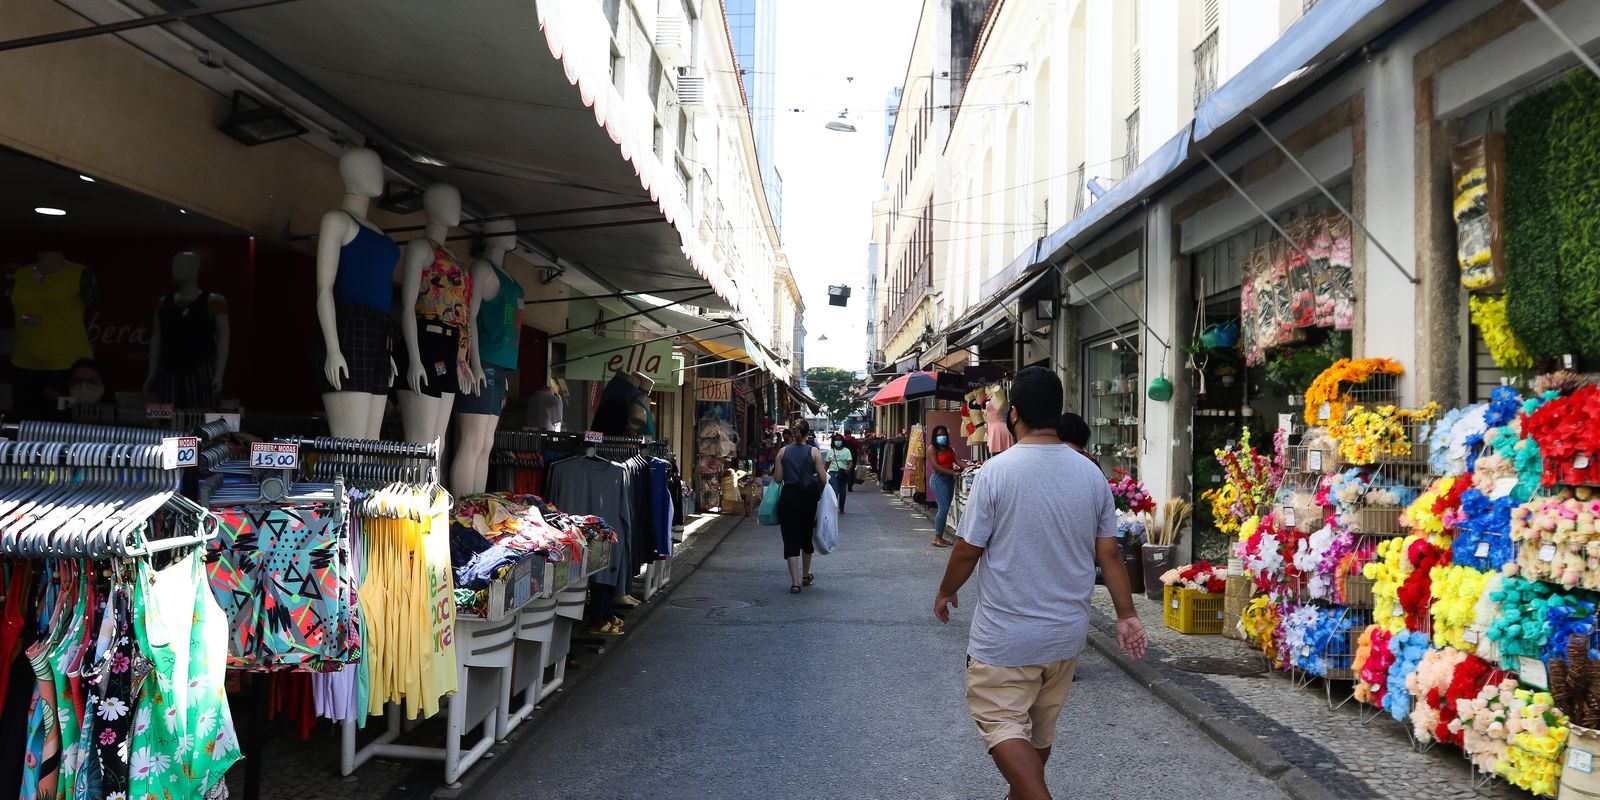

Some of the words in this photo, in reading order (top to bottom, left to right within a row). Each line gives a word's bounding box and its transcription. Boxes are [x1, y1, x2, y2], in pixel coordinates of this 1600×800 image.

[87, 311, 149, 345] bera
[700, 380, 729, 400] TOBA
[278, 445, 296, 453] MODAS
